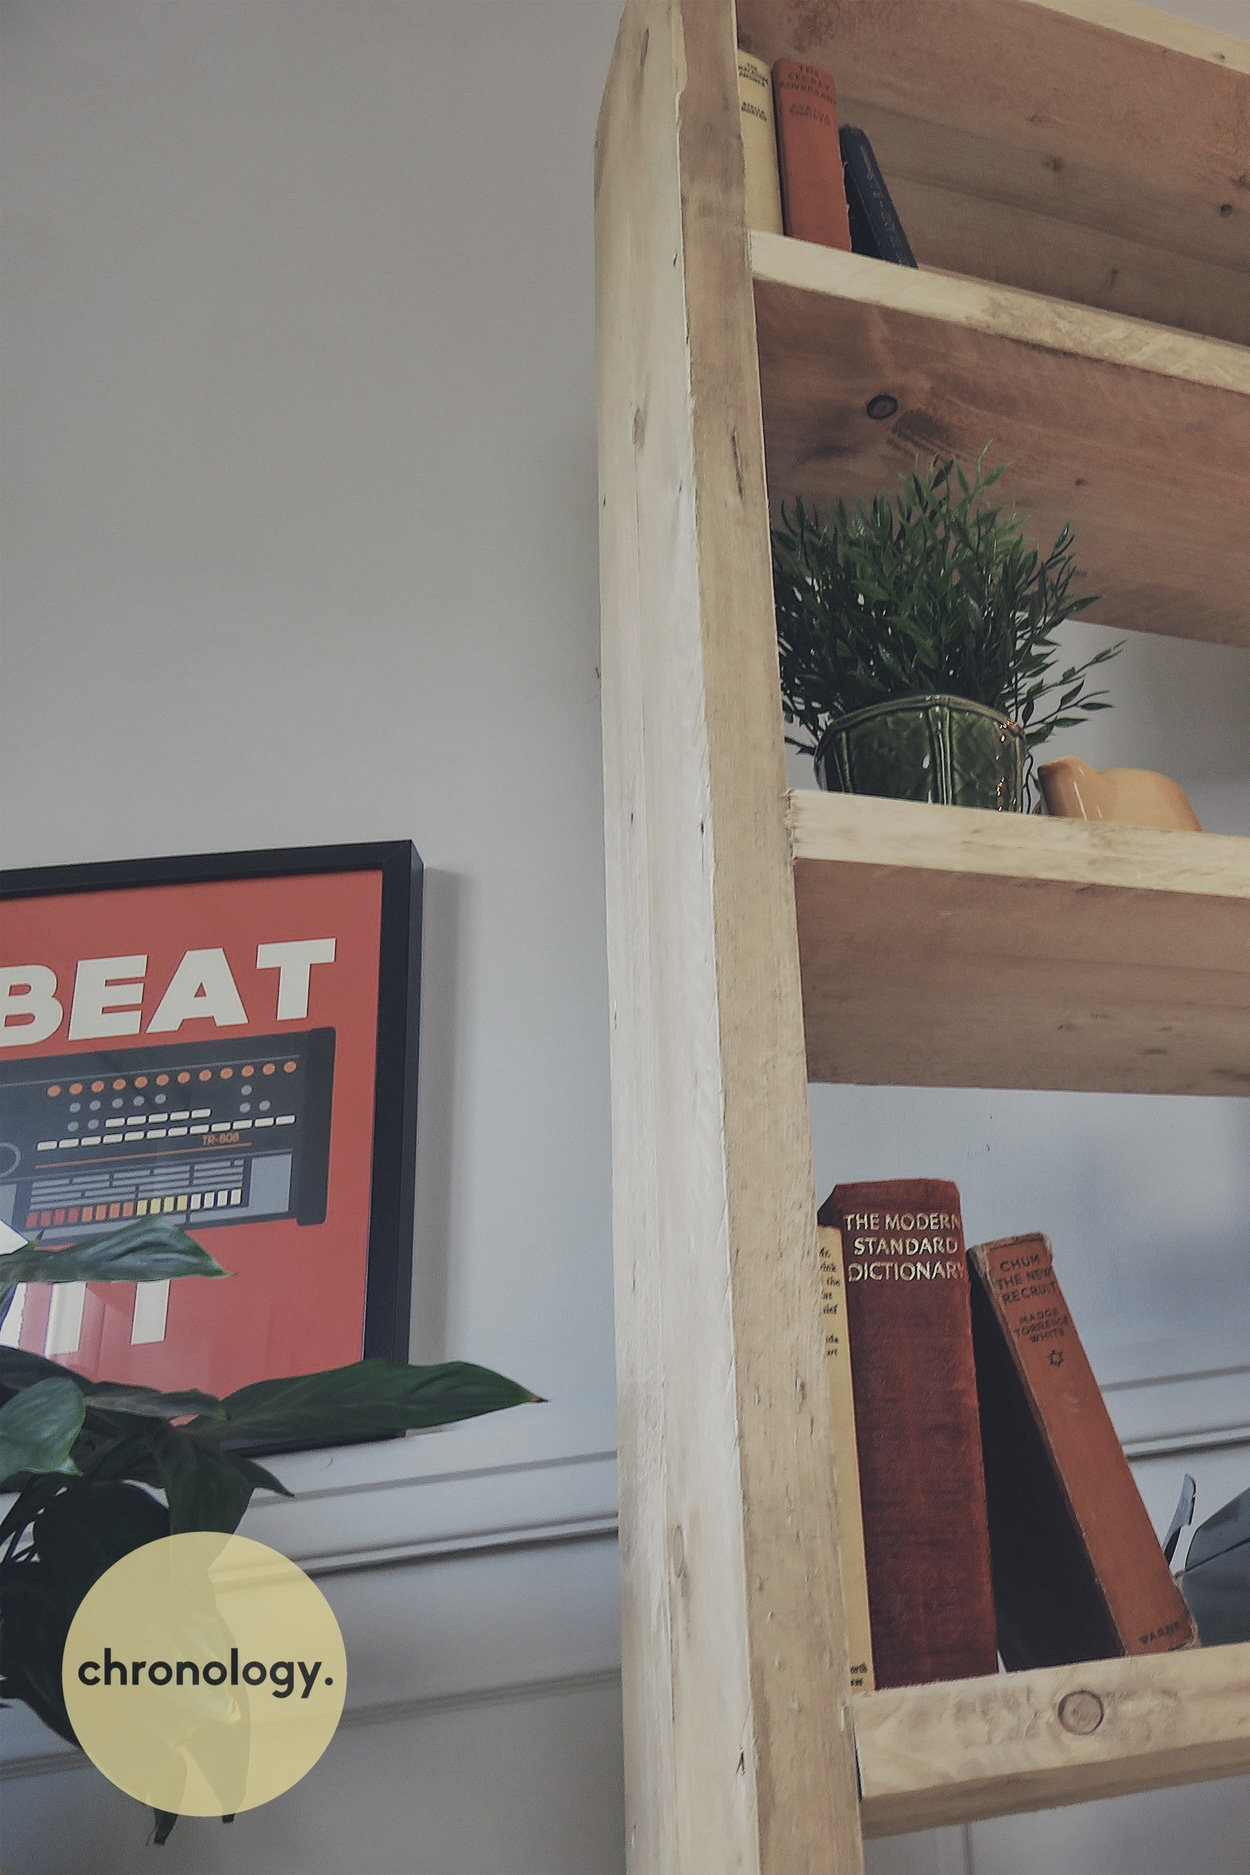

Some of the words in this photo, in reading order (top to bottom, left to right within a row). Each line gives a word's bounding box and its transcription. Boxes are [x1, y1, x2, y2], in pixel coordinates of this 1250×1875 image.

[0, 937, 337, 1048] BEAT
[844, 1212, 880, 1231] THE
[885, 1212, 961, 1231] MODERN
[854, 1237, 958, 1255] STANDARD
[848, 1261, 964, 1282] DICTIONARY
[1000, 1253, 1040, 1272] CHUM
[997, 1273, 1022, 1290] THE
[1002, 1281, 1057, 1304] RECRUIT
